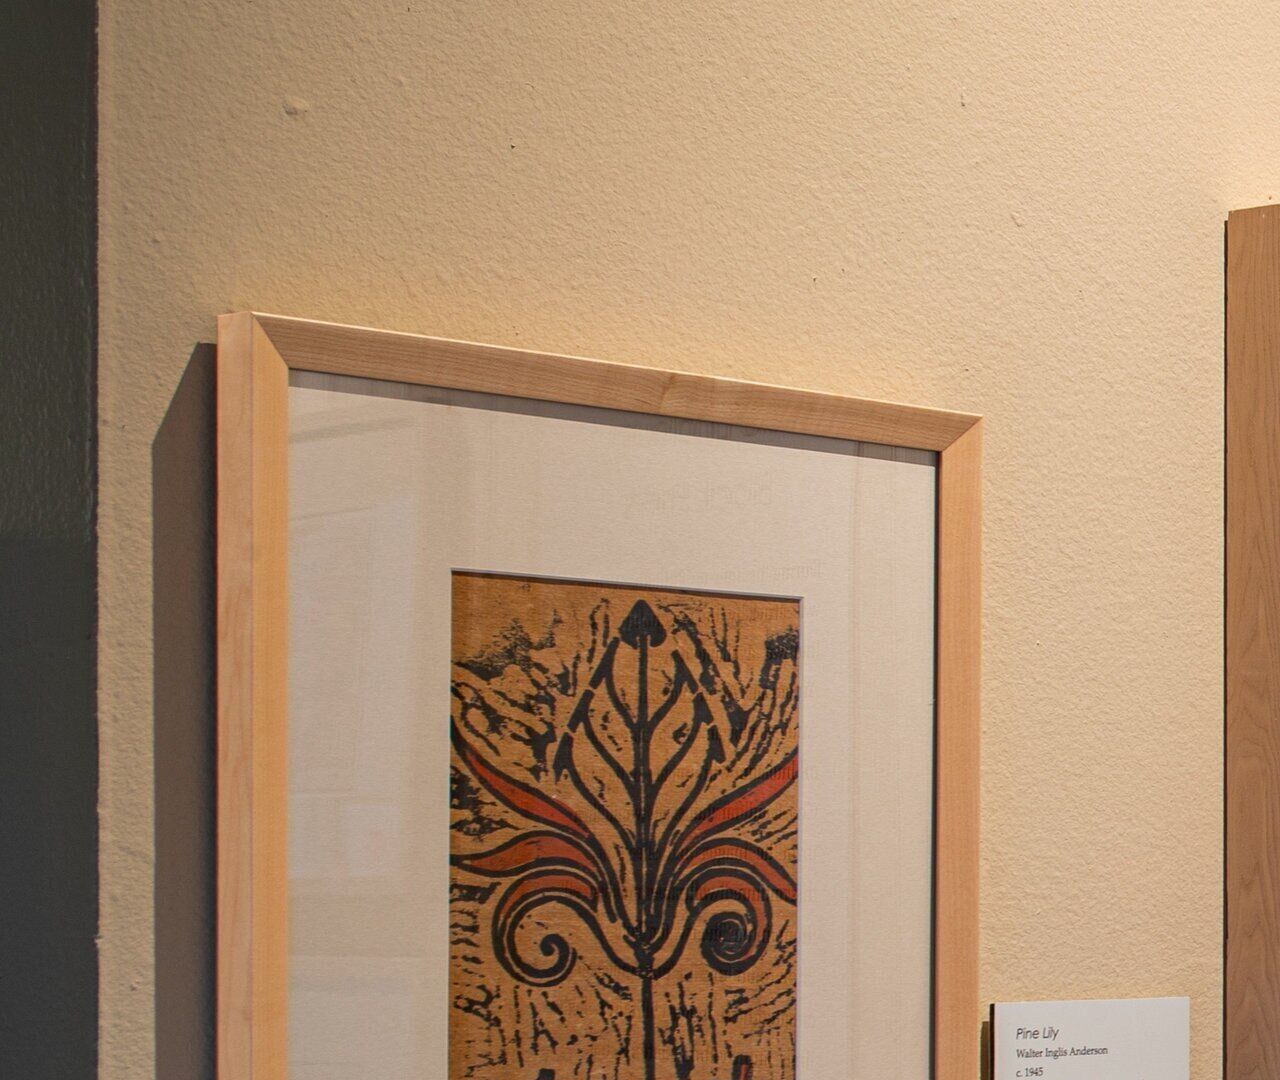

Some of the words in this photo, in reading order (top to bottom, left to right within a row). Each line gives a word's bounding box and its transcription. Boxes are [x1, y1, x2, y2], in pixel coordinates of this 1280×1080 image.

[1015, 1027, 1039, 1039] Pine
[1042, 1026, 1059, 1040] Lily
[1015, 1048, 1043, 1058] Walter
[1044, 1047, 1067, 1059] Inglis
[1069, 1045, 1108, 1056] Anderson
[1024, 1066, 1043, 1077] 1945
